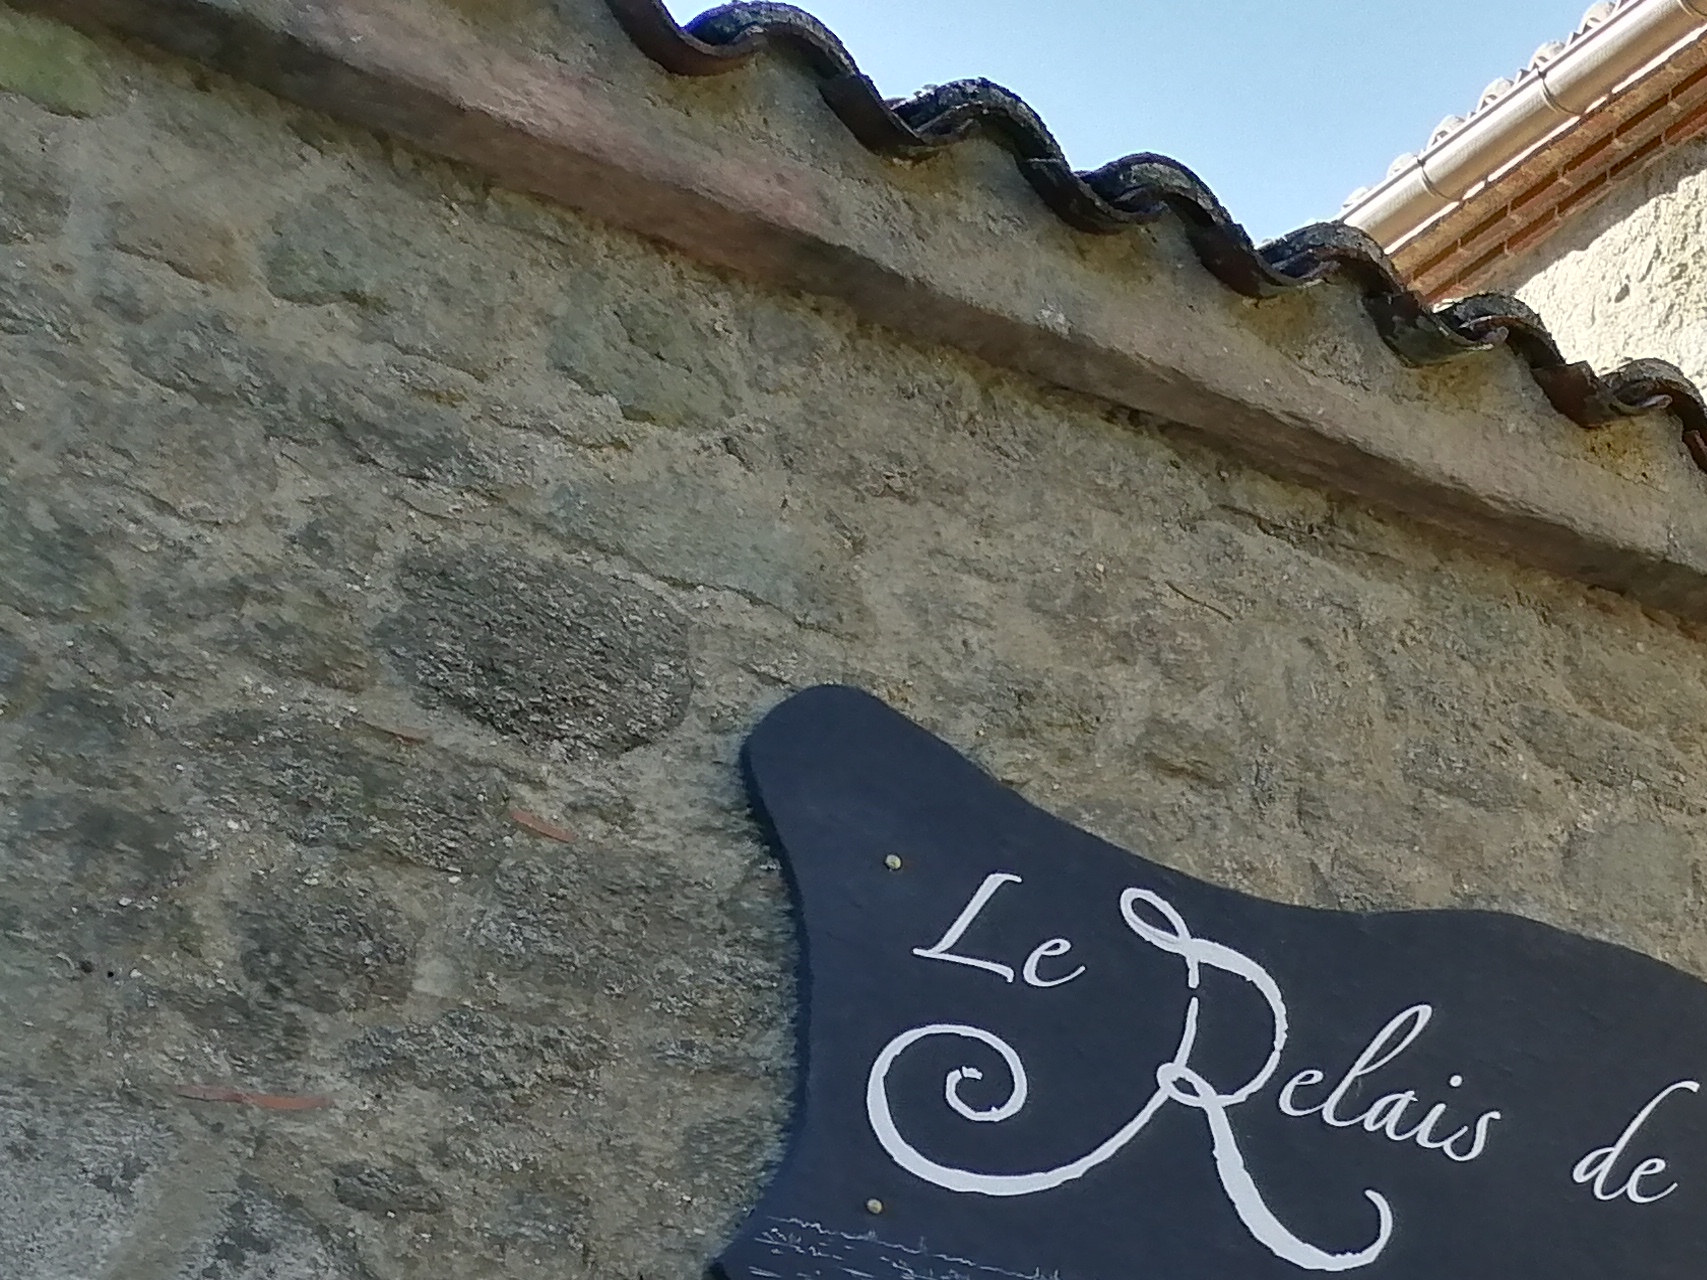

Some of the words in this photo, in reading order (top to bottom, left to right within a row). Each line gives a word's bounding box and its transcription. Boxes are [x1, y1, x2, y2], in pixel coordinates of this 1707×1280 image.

[912, 872, 1084, 988] Le
[866, 887, 1500, 1271] Relais
[1571, 1081, 1699, 1203] de
